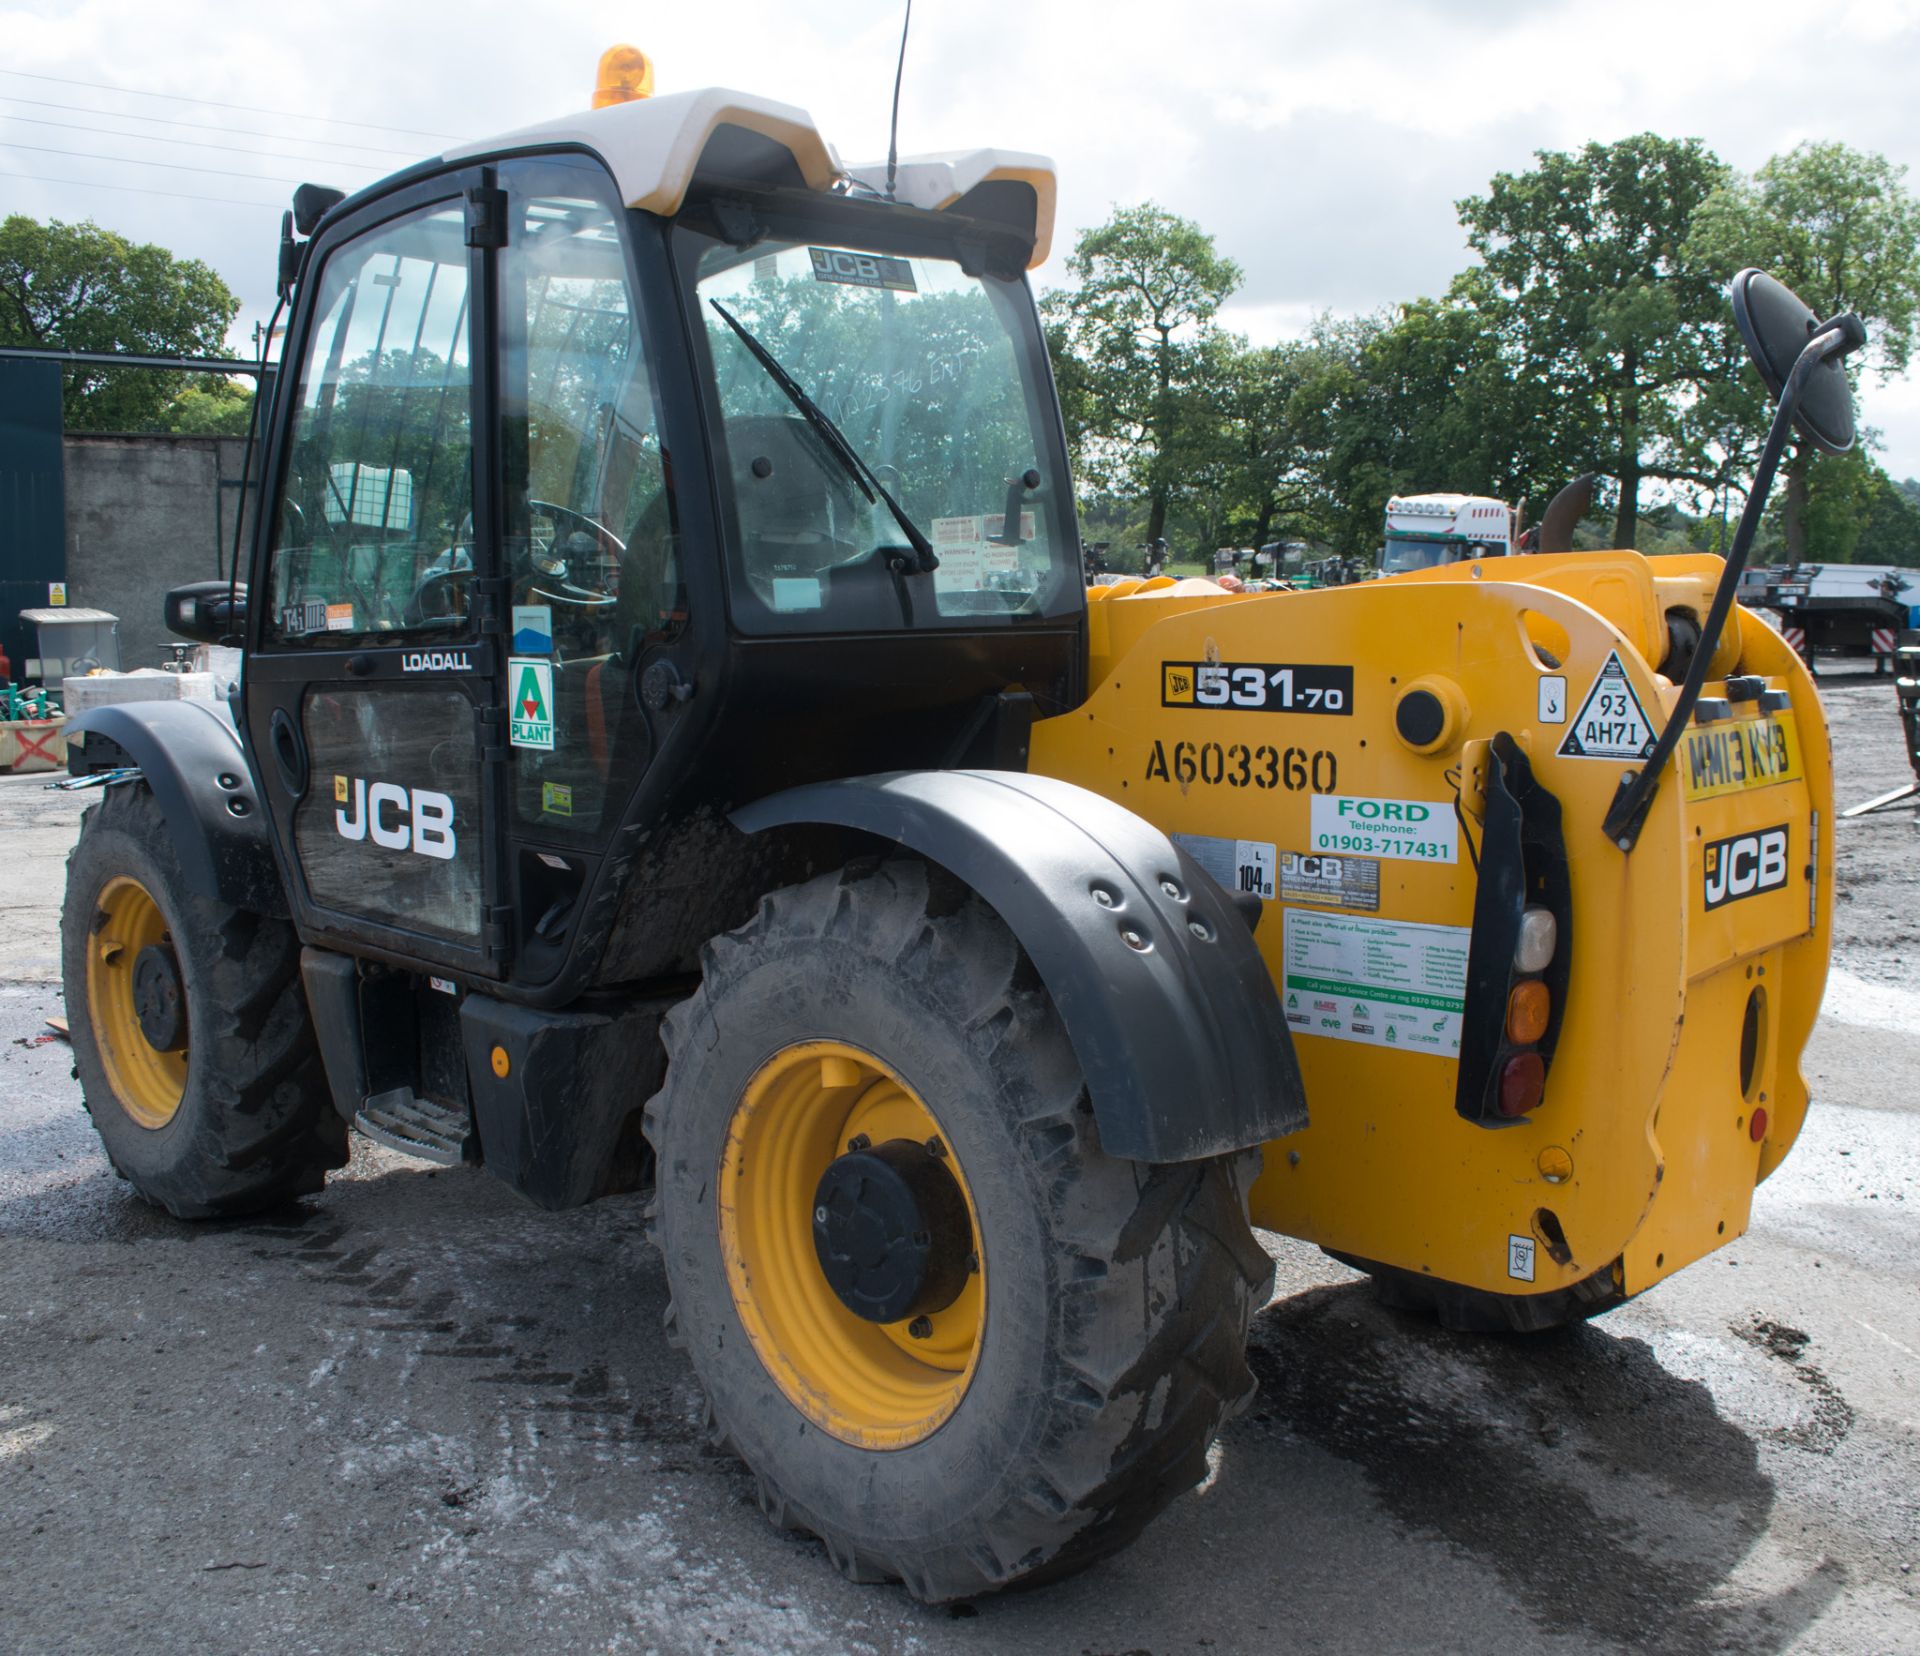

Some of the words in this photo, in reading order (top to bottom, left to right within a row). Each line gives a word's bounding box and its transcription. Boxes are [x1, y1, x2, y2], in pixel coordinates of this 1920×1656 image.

[814, 251, 879, 279] JCB
[817, 273, 882, 287] GREENSHIELDS
[402, 652, 472, 672] LOADALL
[513, 666, 548, 721] A
[1600, 695, 1627, 717] 93
[511, 723, 551, 742] PLANT
[1145, 740, 1337, 794] A603360
[335, 778, 456, 860] JCB
[1338, 799, 1430, 822] FORD
[1349, 819, 1417, 835] Telephone:
[1255, 851, 1262, 860] L
[1318, 833, 1449, 859] 01903-717431
[1239, 864, 1262, 893] 104
[1281, 854, 1343, 880] JCB
[1705, 830, 1787, 904] JCB
[1321, 1018, 1341, 1029] eve
